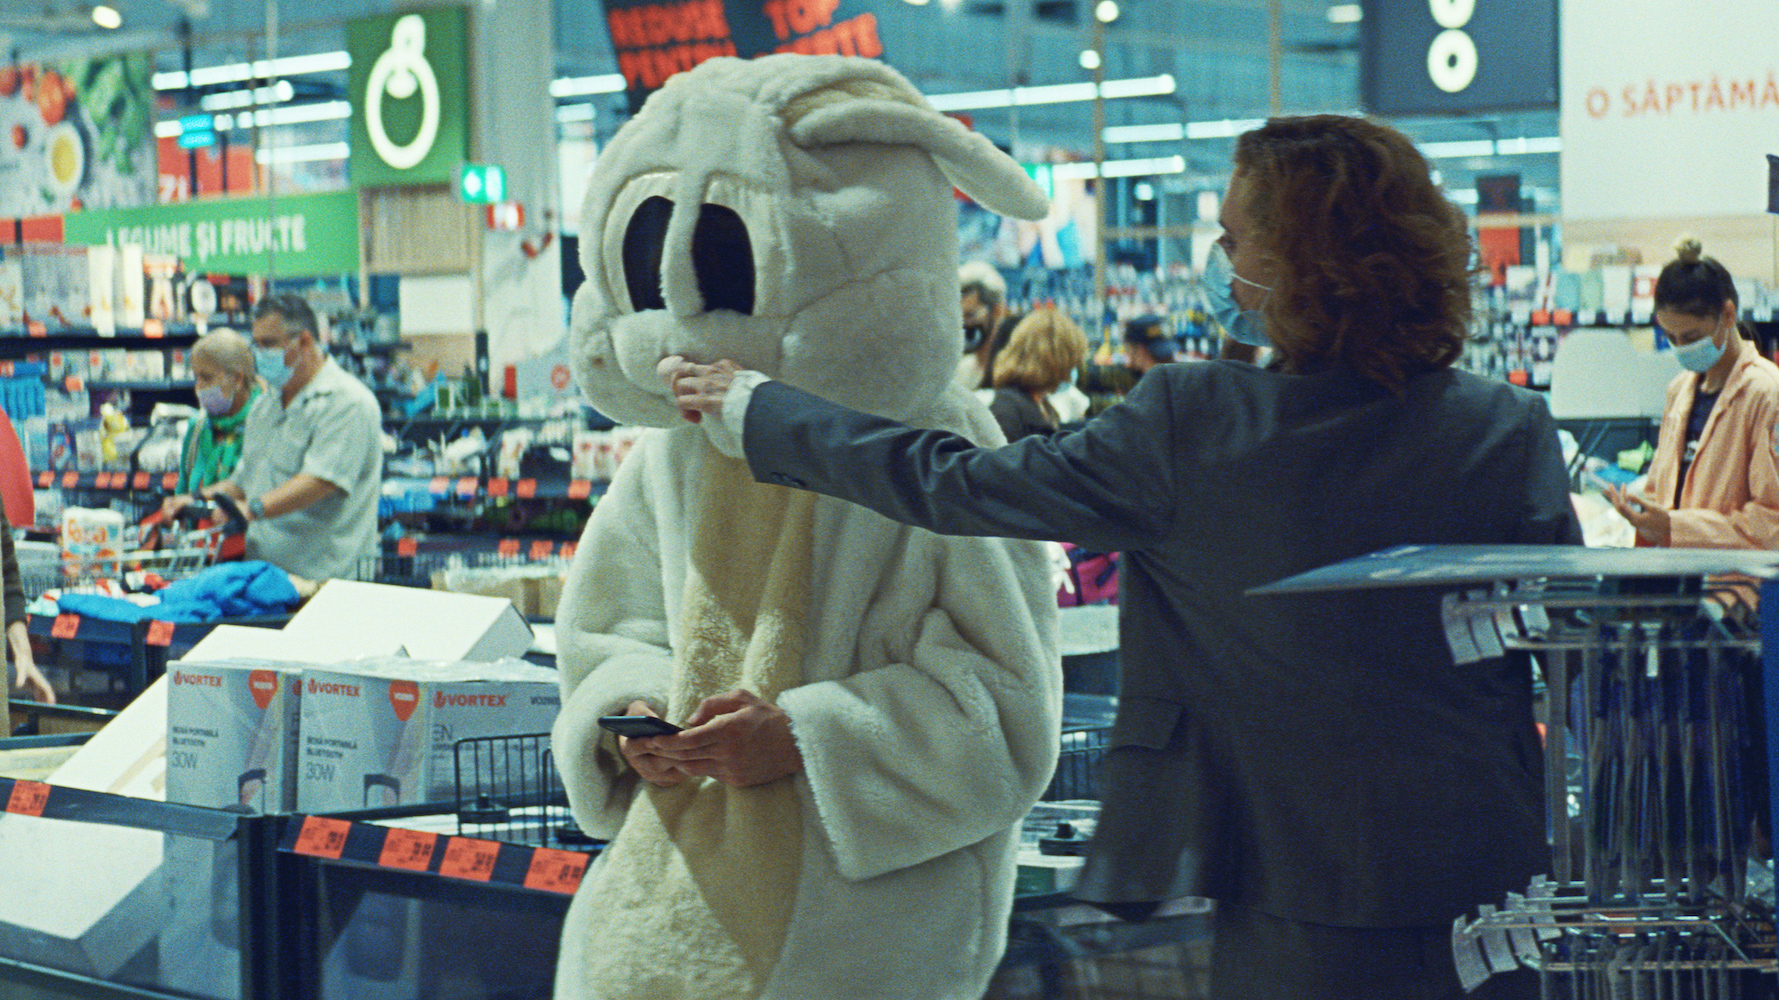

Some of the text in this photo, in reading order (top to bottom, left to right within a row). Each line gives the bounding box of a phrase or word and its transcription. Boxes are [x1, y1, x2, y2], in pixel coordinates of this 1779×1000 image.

[1583, 86, 1610, 121] O
[221, 214, 306, 255] FRUCTE
[183, 674, 222, 687] VORTEX
[318, 682, 360, 697] VORTEX
[447, 694, 506, 707] VORTEX
[306, 762, 335, 781] 30W
